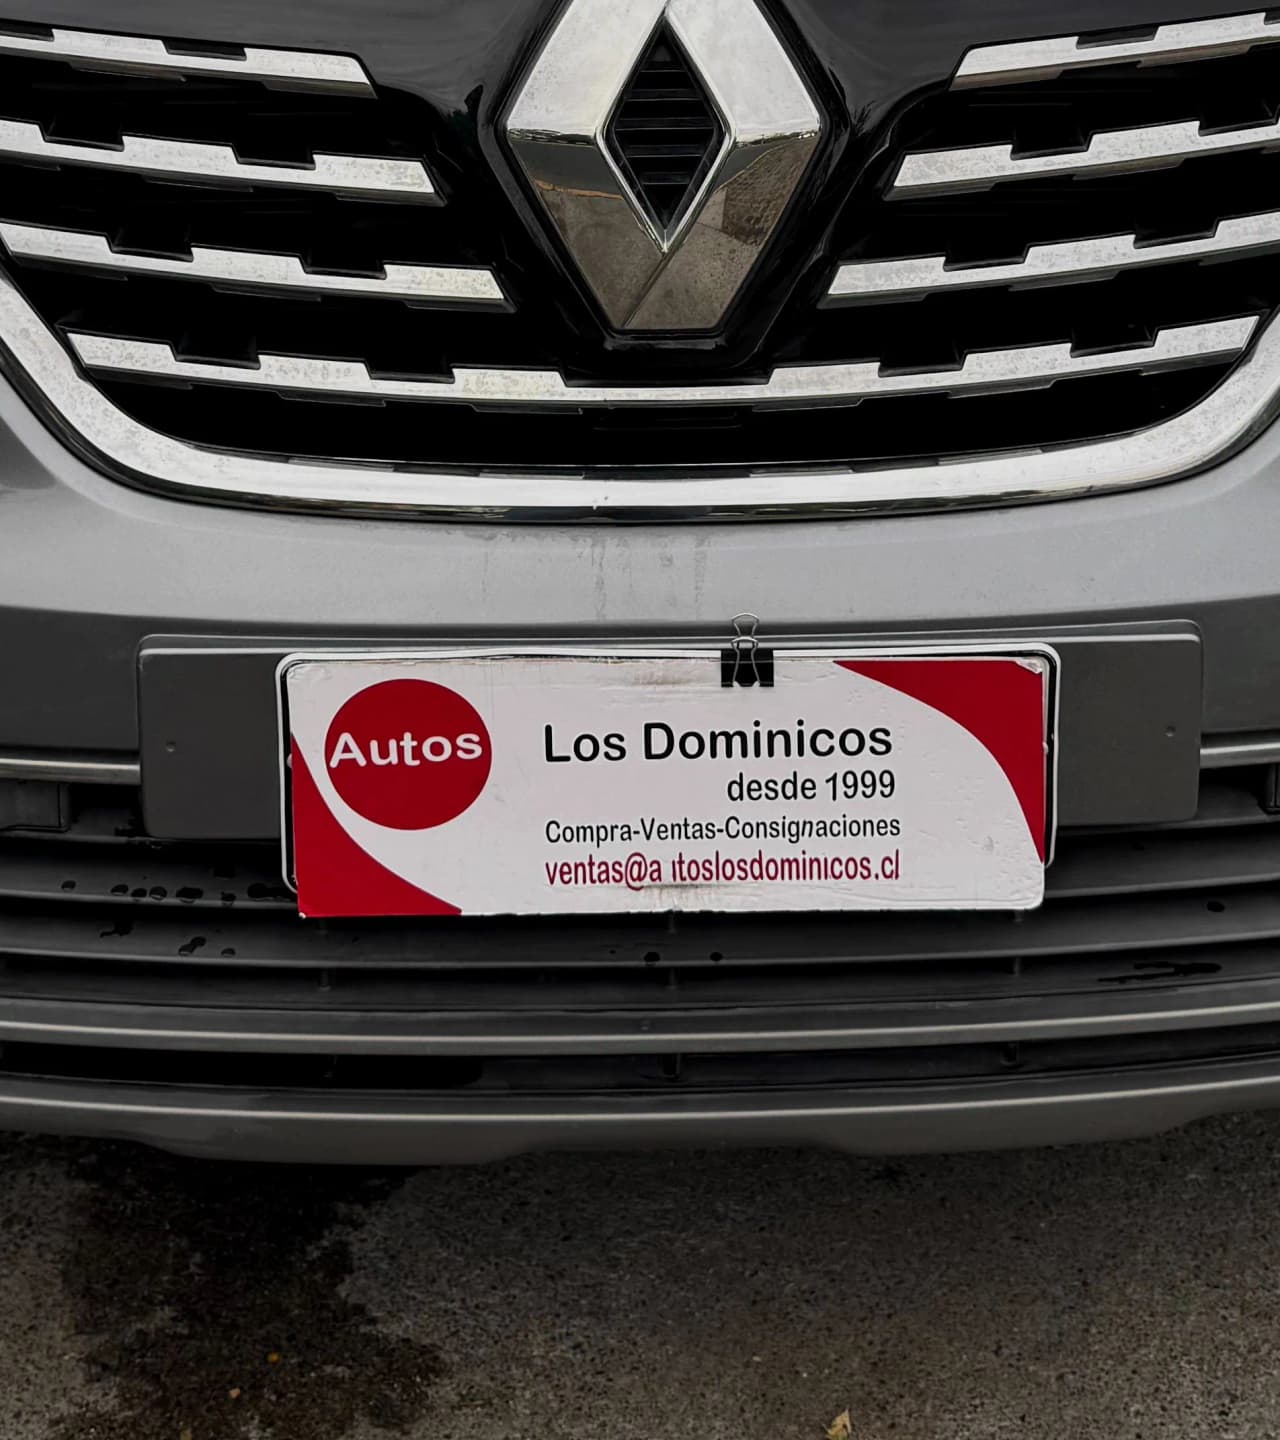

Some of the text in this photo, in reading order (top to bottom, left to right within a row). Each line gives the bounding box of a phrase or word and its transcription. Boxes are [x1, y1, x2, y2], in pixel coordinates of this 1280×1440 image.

[329, 731, 483, 768] Autos
[544, 719, 893, 763] Los Dominicos
[726, 769, 896, 802] desde 1999
[545, 814, 901, 848] Compra-Ventas-Consignaciones
